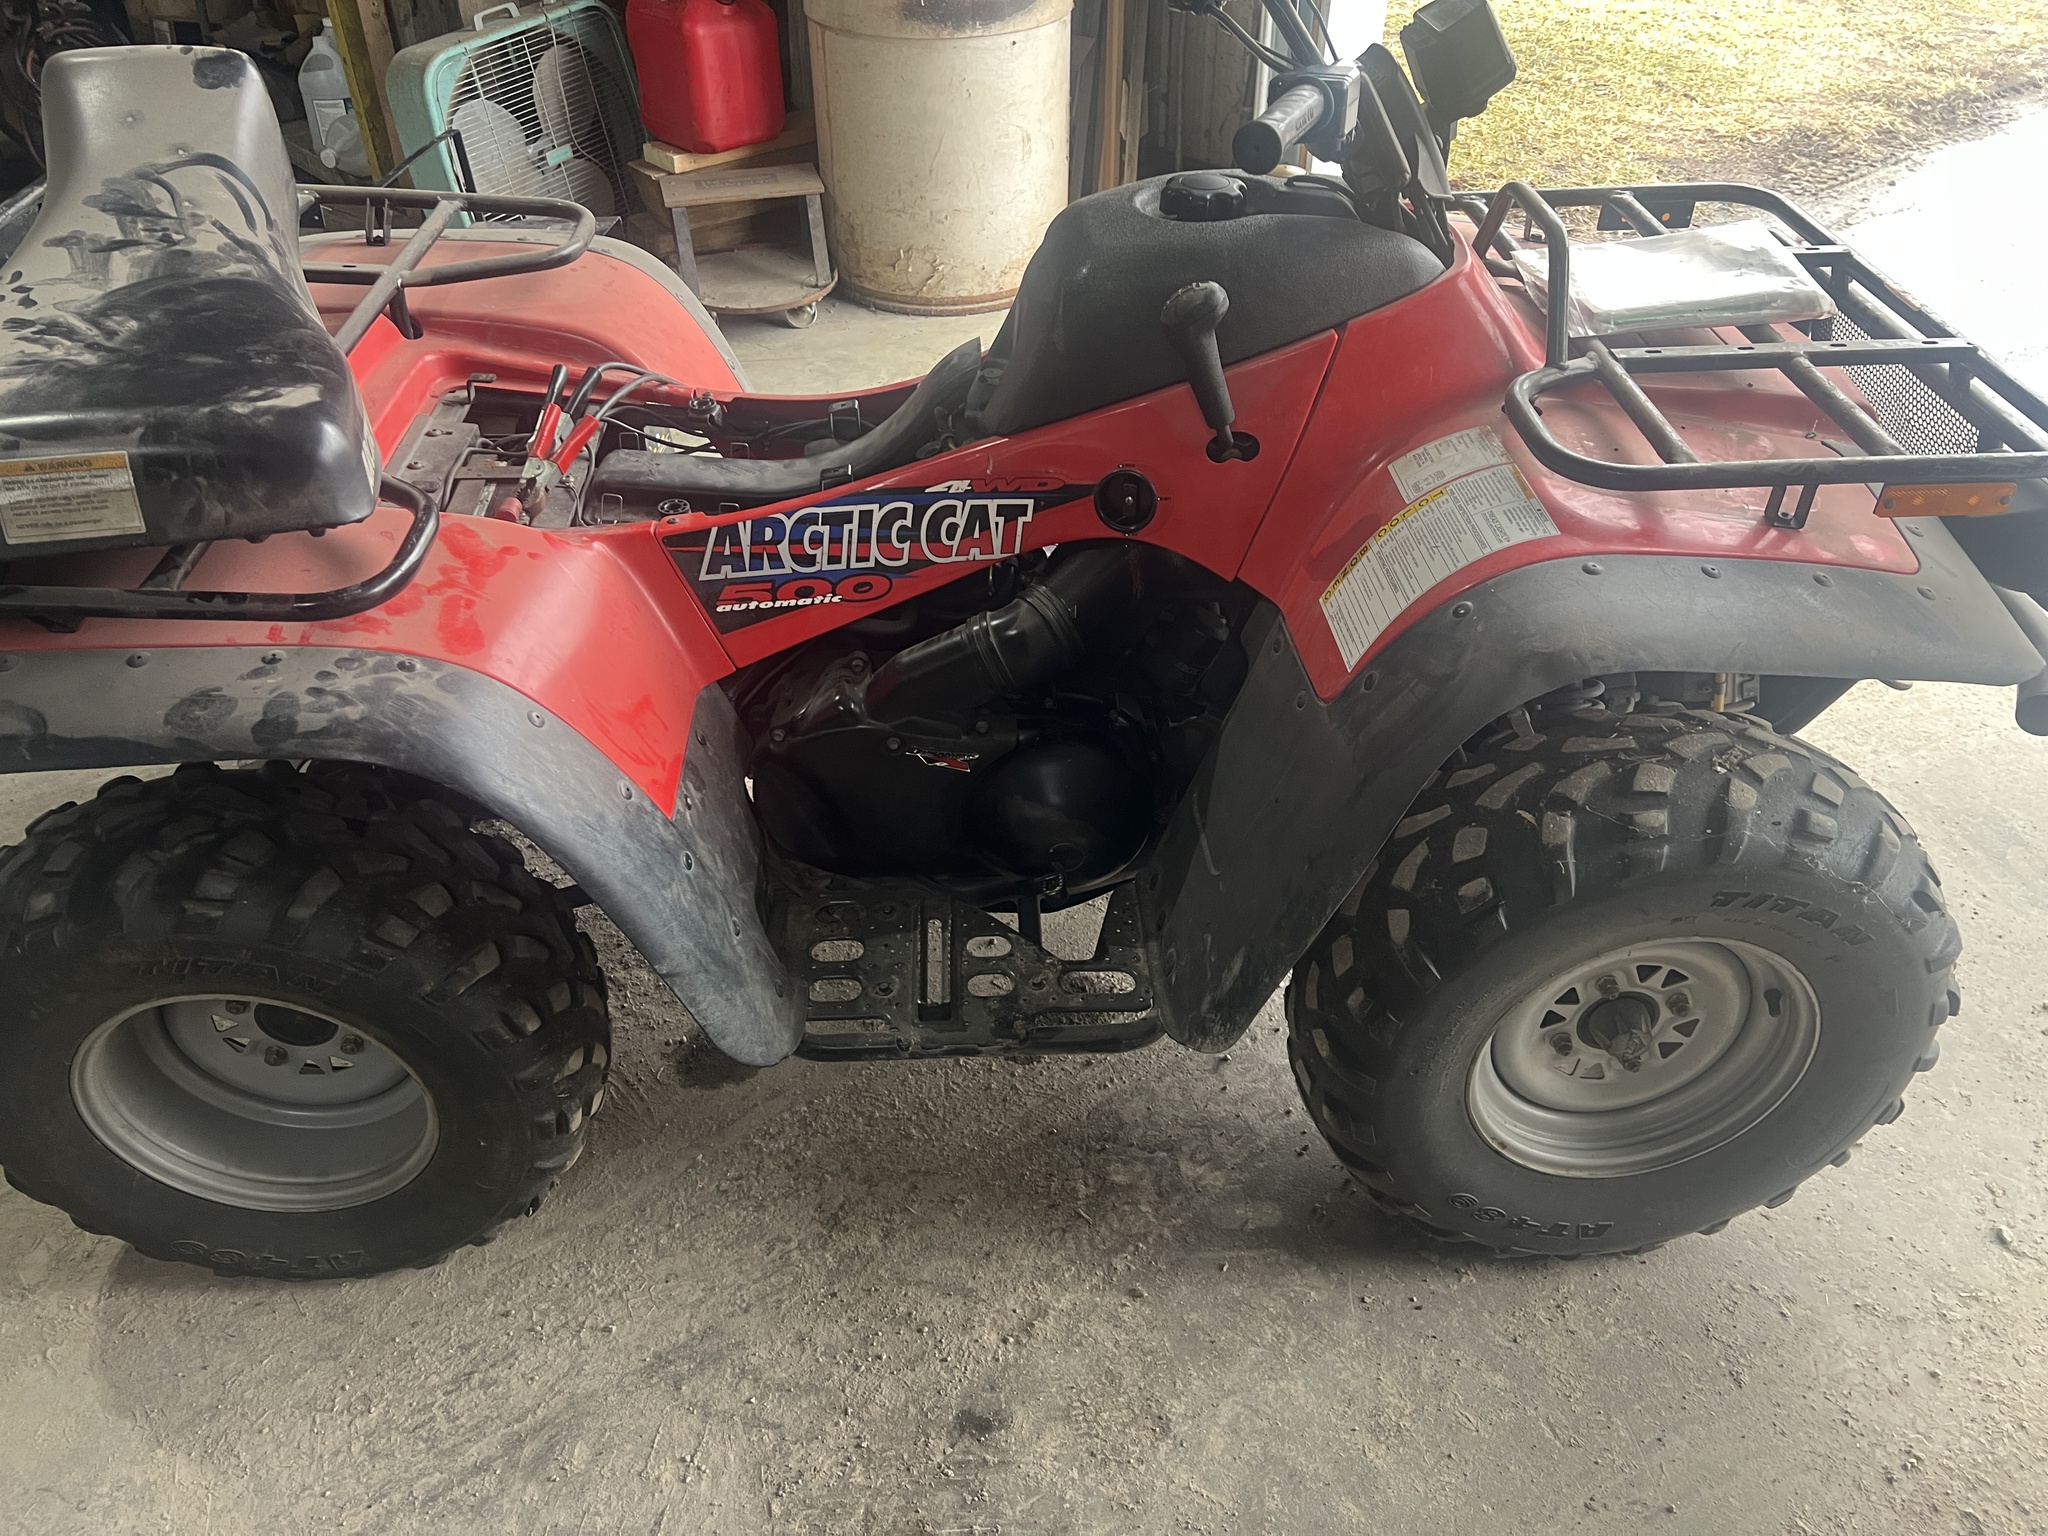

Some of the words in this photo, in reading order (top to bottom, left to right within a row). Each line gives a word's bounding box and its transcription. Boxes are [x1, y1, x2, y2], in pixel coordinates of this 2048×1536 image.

[38, 460, 93, 471] WARNING
[925, 478, 1066, 493] 4WD
[700, 503, 913, 580] ARCTIC
[920, 499, 1034, 563] CAT
[717, 575, 894, 605] 500
[716, 594, 842, 612] automatic
[1710, 890, 1877, 946] TITAN
